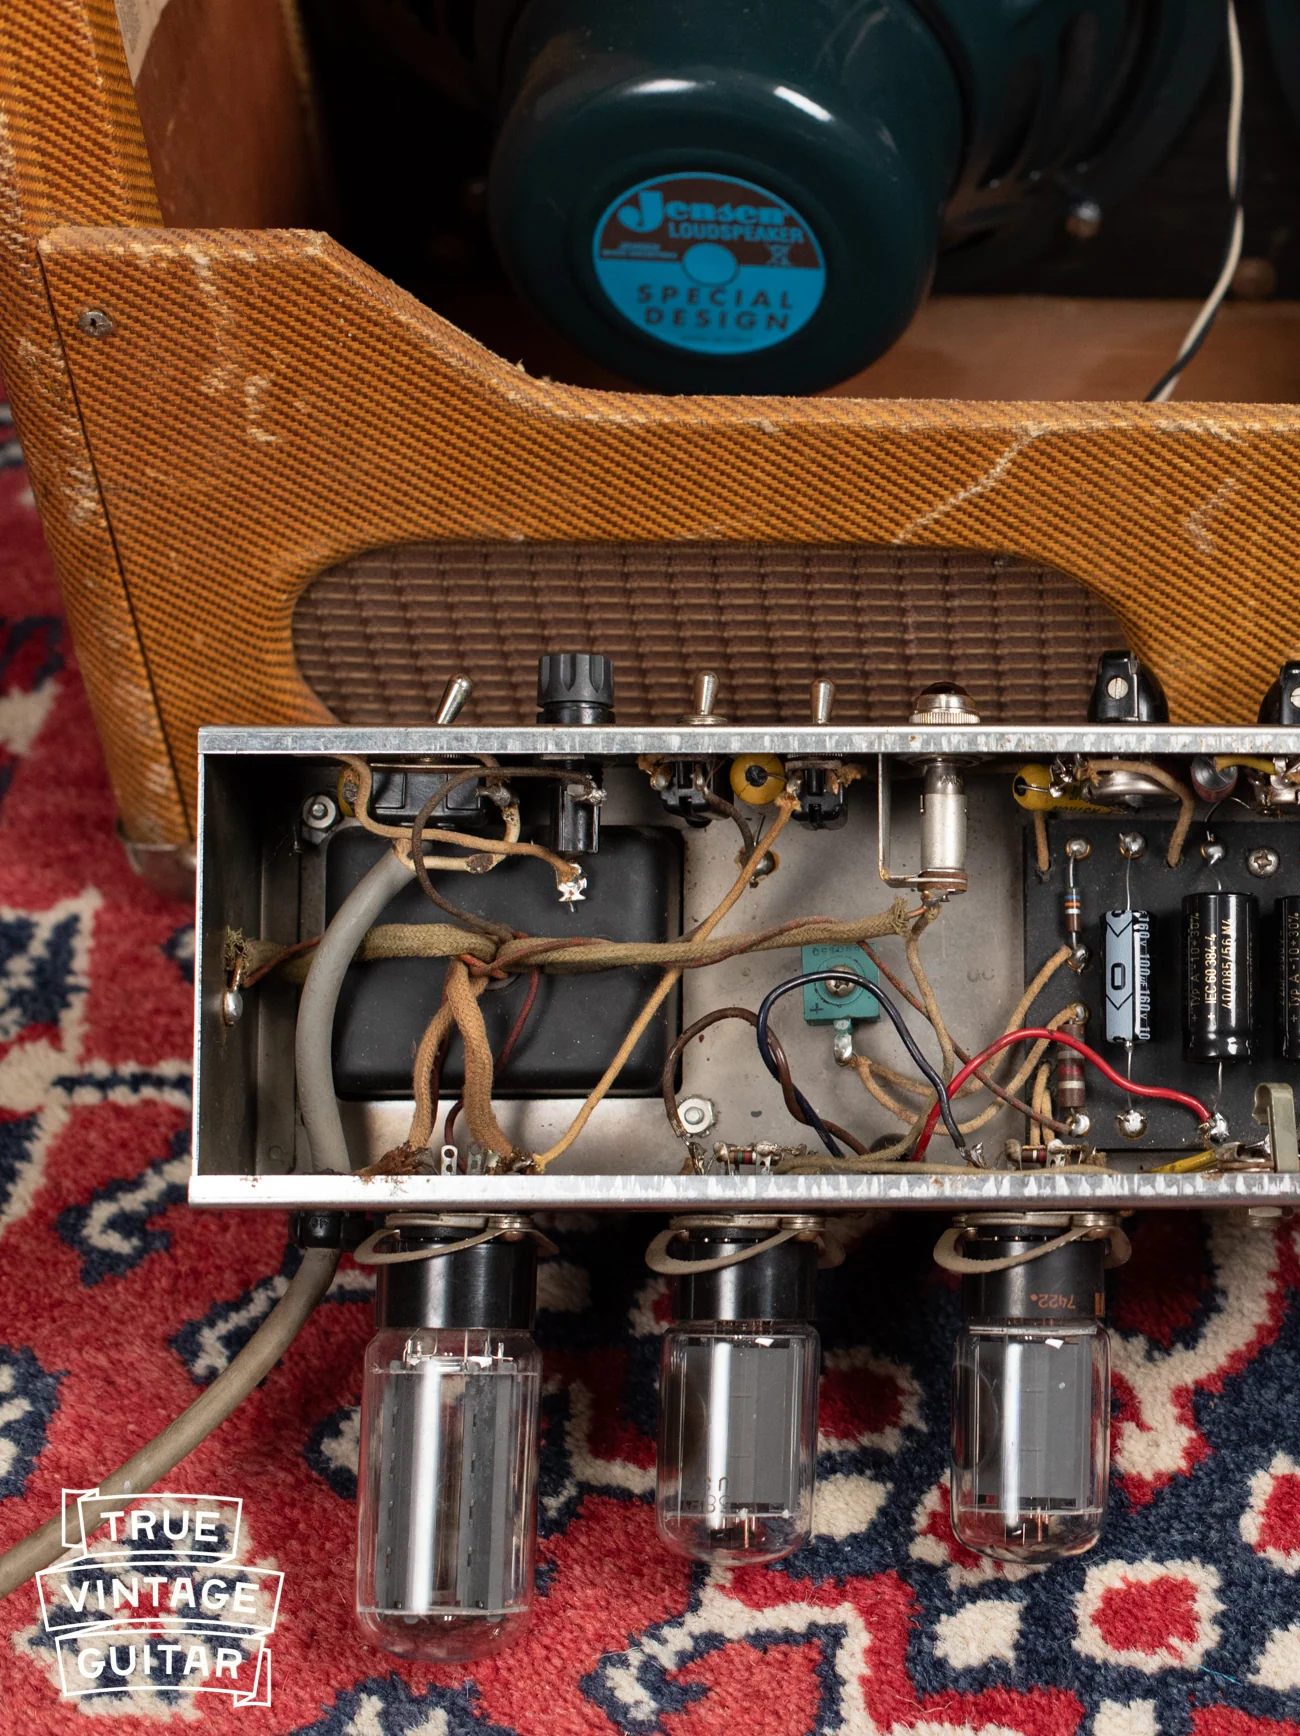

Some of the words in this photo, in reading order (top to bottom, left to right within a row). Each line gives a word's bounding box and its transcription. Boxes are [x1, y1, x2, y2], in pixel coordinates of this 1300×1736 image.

[617, 190, 786, 233] Jensen
[668, 222, 805, 244] LOUDSPEAKER
[637, 284, 792, 309] SPECIAL
[644, 307, 789, 332] DESIGN
[1204, 985, 1217, 1004] IEC
